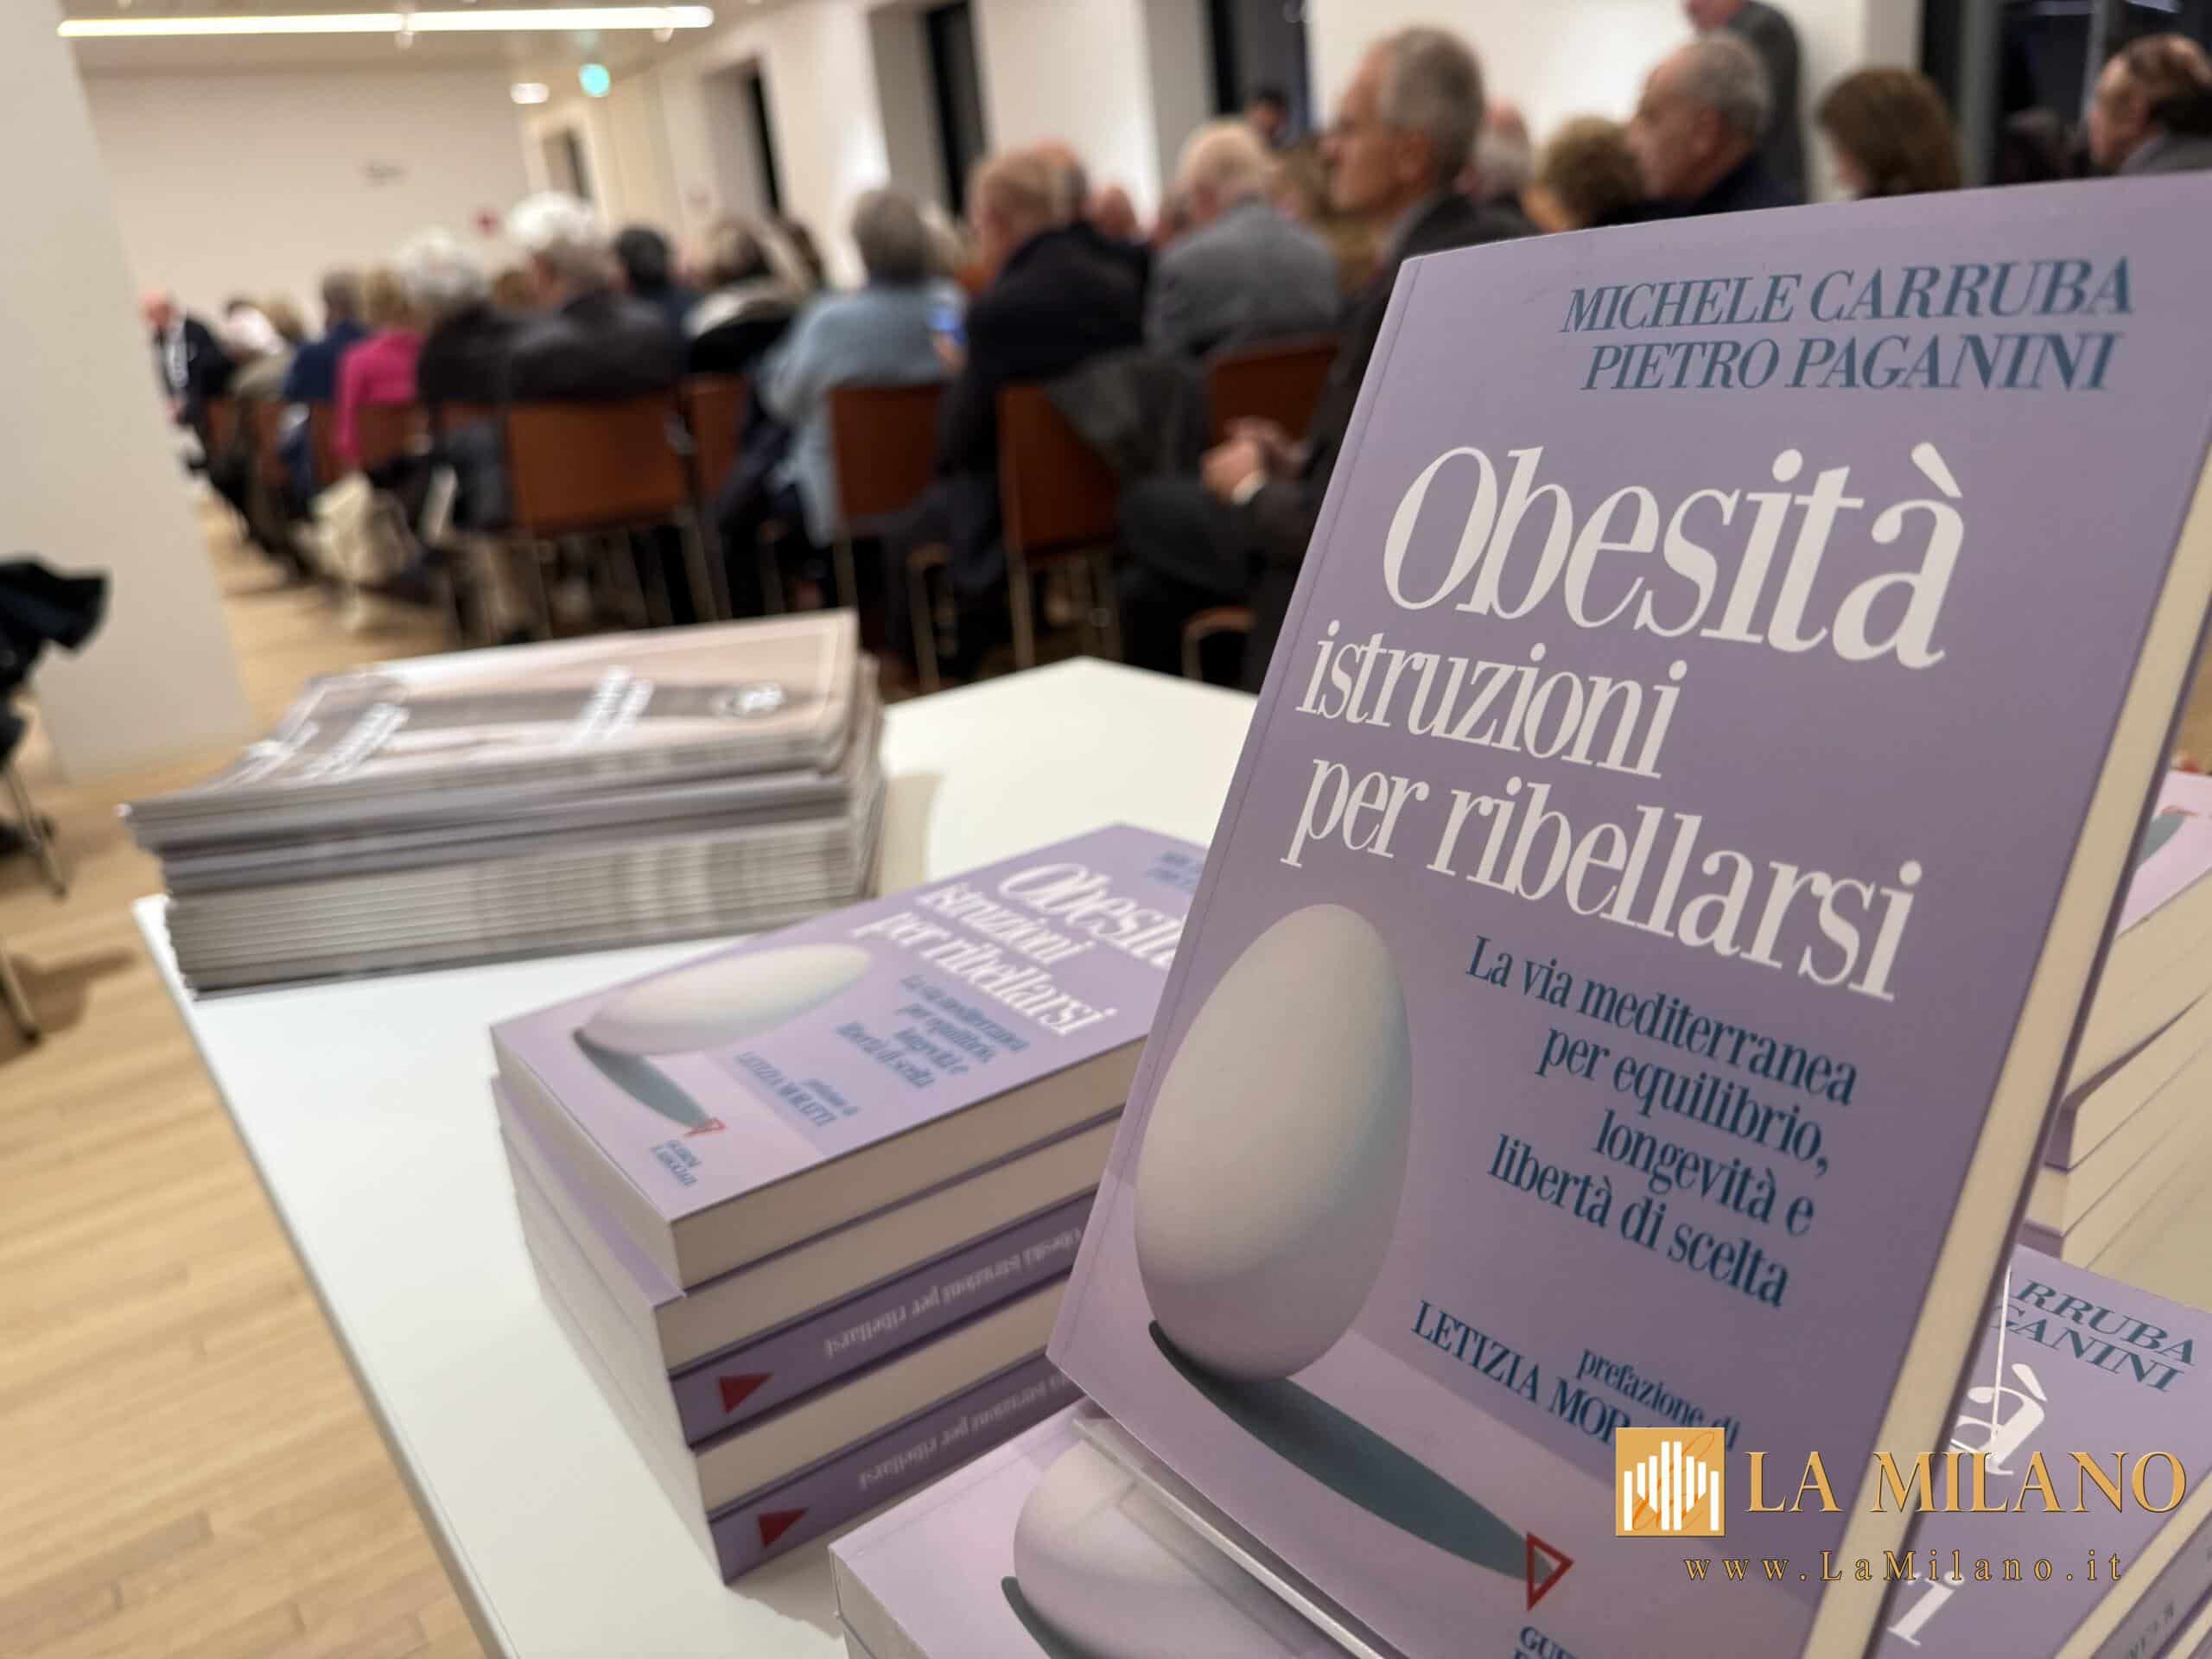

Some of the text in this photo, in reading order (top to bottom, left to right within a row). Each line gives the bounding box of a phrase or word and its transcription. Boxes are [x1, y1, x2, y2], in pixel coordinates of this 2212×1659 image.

[1559, 256, 2133, 334] MICHELE CARRUBA
[1580, 332, 2125, 391] PIETRO PAGANINI
[1383, 442, 1965, 671] Obesità
[1296, 620, 1686, 780] istruzioni
[998, 862, 1185, 970] Obesit
[1281, 759, 1923, 1002] per ribellarsi
[1465, 935, 1858, 1106] La via mediterranea
[1535, 1027, 1829, 1176] per equilibrio,
[1487, 1134, 1790, 1308] libertà di scelta
[1592, 1109, 1815, 1236] longevità e
[1410, 1300, 1542, 1403] LETIZIA
[1576, 1349, 1704, 1427] prefazione
